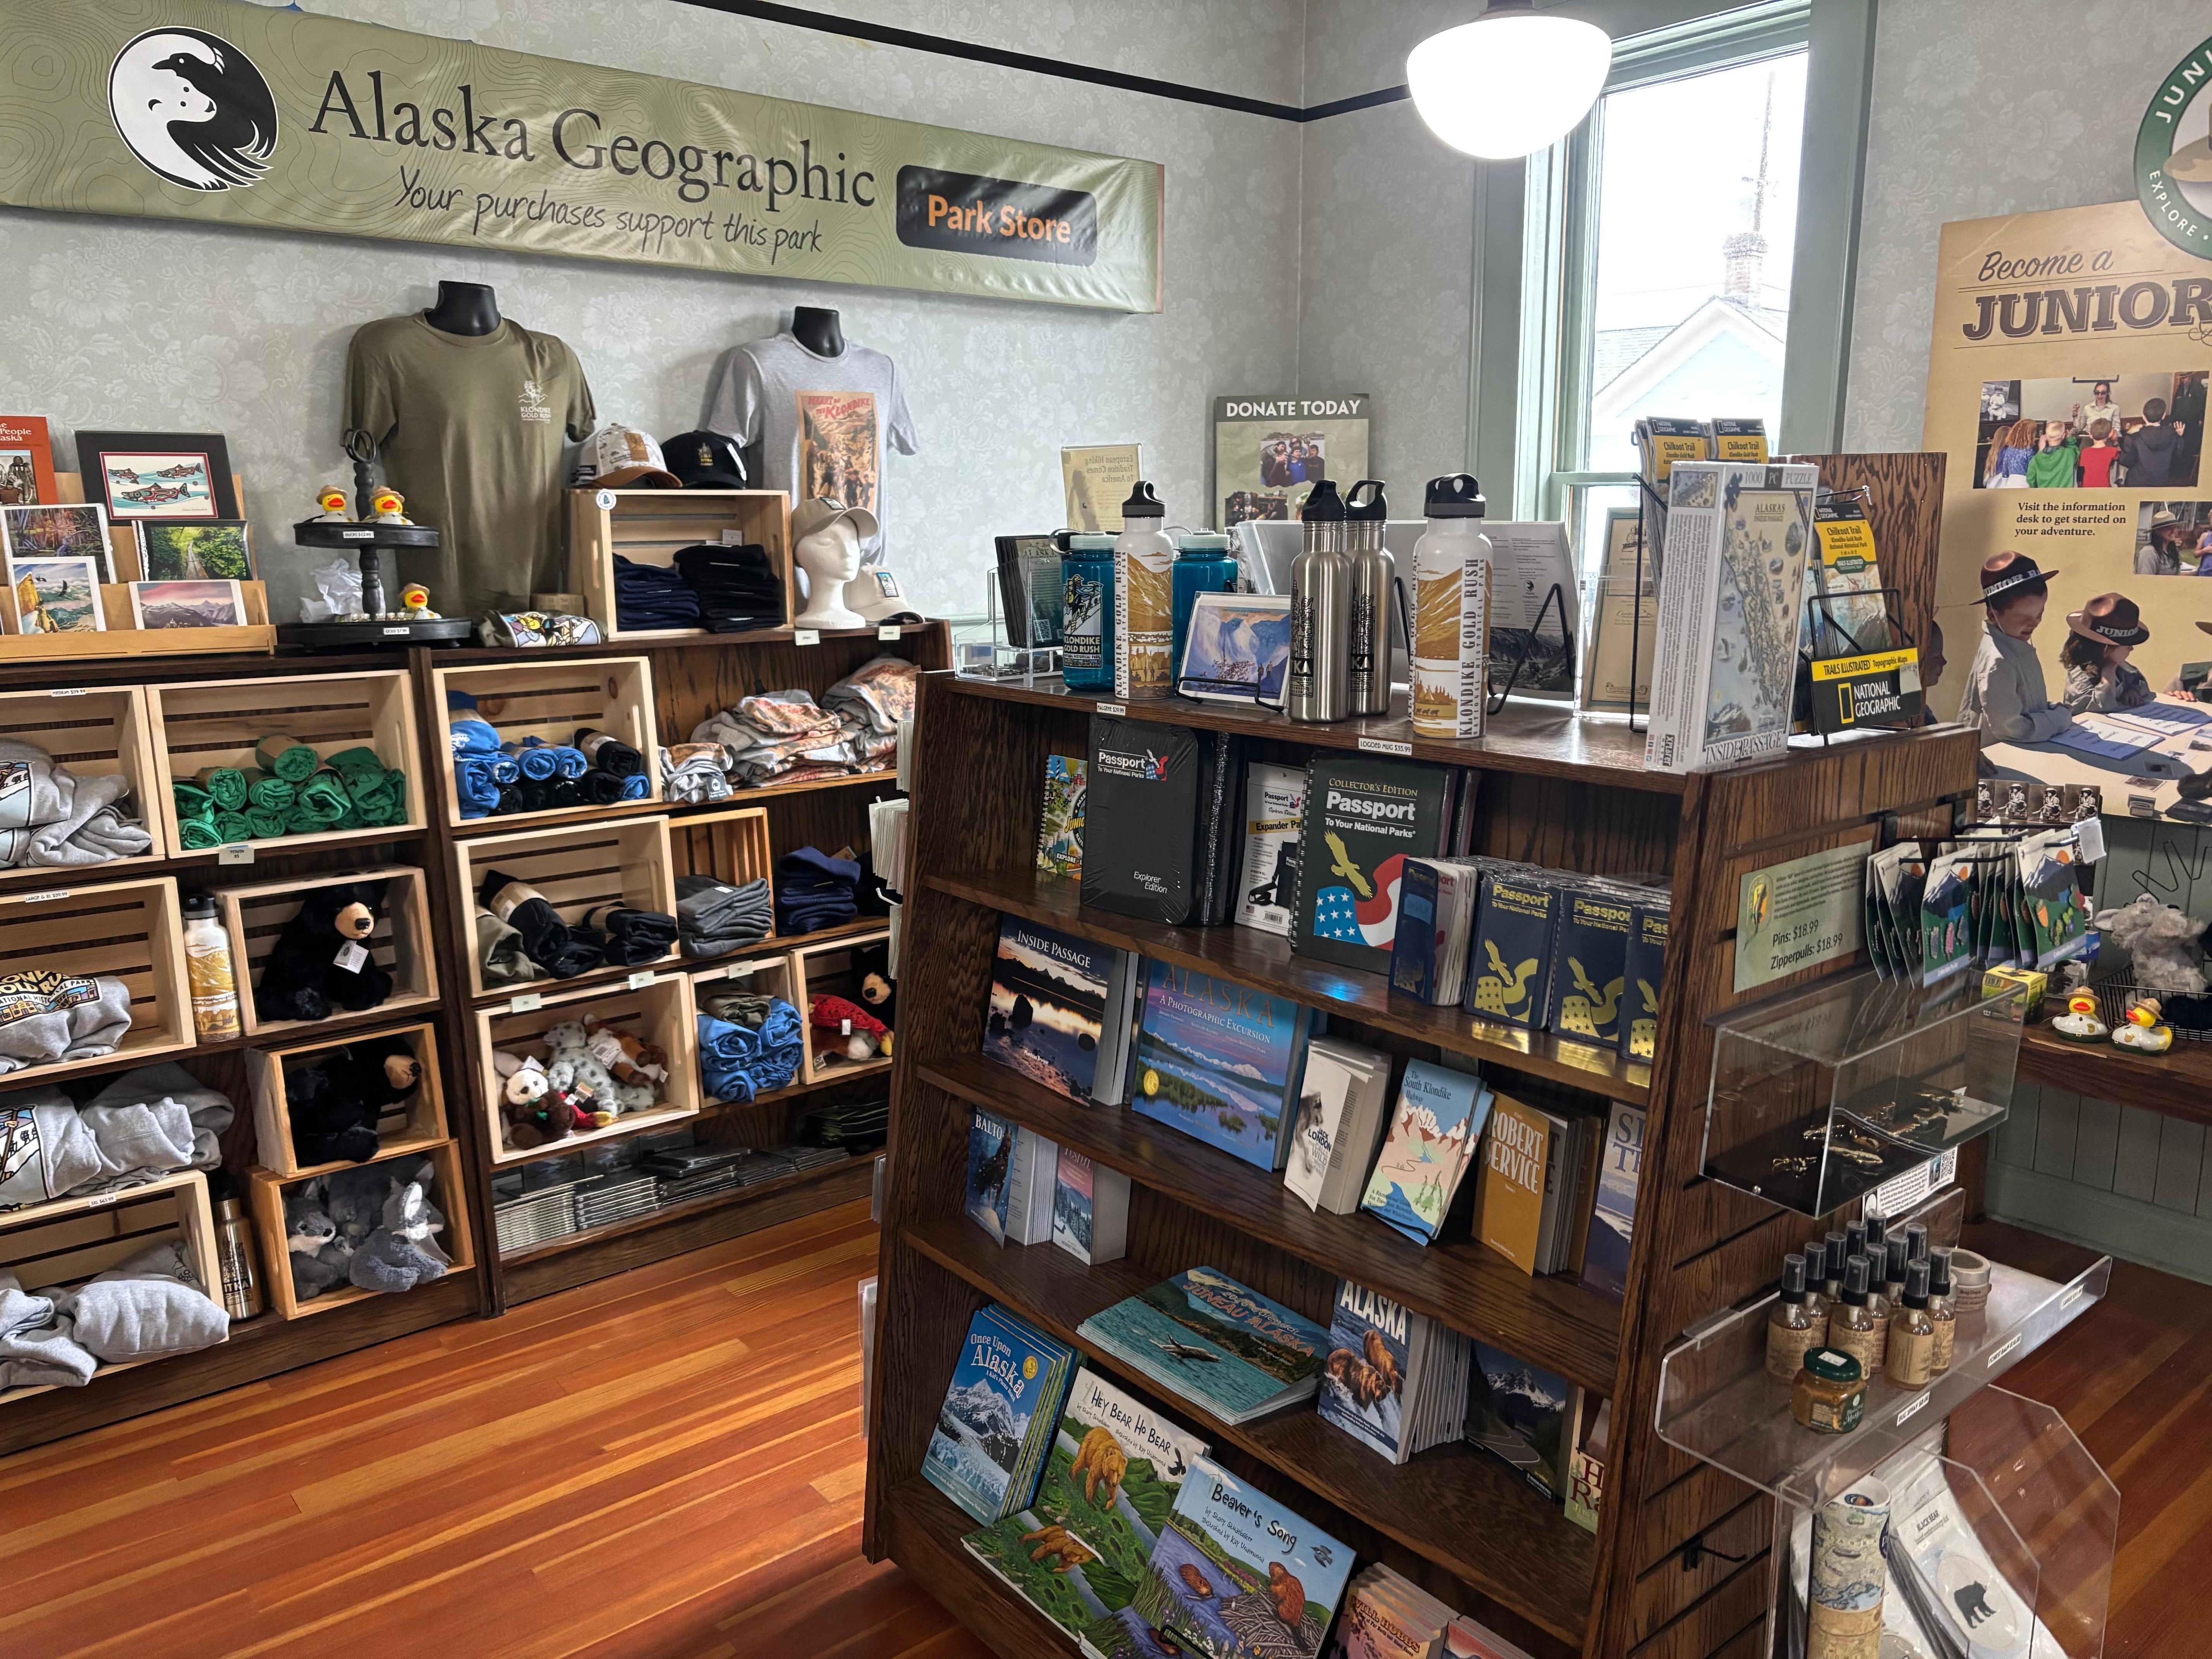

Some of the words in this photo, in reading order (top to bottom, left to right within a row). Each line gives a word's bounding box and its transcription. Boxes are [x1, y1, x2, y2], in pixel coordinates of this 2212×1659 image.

[309, 70, 534, 163] Alaska
[551, 108, 876, 213] Geographic
[400, 165, 464, 211] Your
[474, 189, 605, 235] purchases
[617, 210, 714, 254] support
[723, 210, 768, 247] this
[771, 219, 823, 266] park
[2149, 170, 2197, 237] EXPLORE
[928, 194, 992, 234] Park
[999, 204, 1071, 244] Store
[1978, 249, 2083, 282] Become
[2092, 249, 2114, 271] a
[1962, 277, 2212, 341] JUNIOR
[825, 398, 870, 420] KLONDIKE
[1226, 400, 1296, 417] DONATE
[1301, 399, 1360, 416] TODAY
[0, 428, 32, 436] People
[1664, 442, 1683, 450] Chilkoot
[1685, 442, 1695, 451] Trail
[1728, 441, 1748, 450] Chilkoot
[1749, 441, 1759, 450] Trail
[1745, 471, 1762, 484] 1000
[1769, 472, 1779, 484] PC
[1785, 472, 1812, 484] PUZZLE
[2018, 502, 2040, 511] Visit
[2043, 502, 2059, 511] the
[2062, 502, 2125, 511] information
[1827, 526, 1850, 536] Chilkoot
[1850, 526, 1862, 534] Trail
[2016, 515, 2039, 523] desk
[2054, 516, 2069, 525] get
[2073, 515, 2109, 524] started
[2014, 528, 2039, 538] your
[2041, 527, 2095, 536] adventure.
[1464, 559, 1479, 598] RUSH
[1462, 611, 1476, 649] GOLD
[1475, 598, 1483, 668] HISTORICAL
[1823, 664, 1840, 675] TRAILS
[1841, 659, 1870, 673] ILLUSTRATED
[1872, 657, 1897, 668] Topographic
[1898, 655, 1908, 664] Maps
[1460, 661, 1475, 736] KLONDIKE
[1853, 680, 1891, 700] NATIONAL
[1855, 696, 1901, 718] GEOGRAPHIC
[1360, 740, 1381, 749] LOGOED
[1382, 742, 1393, 751] MUG
[1394, 744, 1411, 753] $35.99
[1705, 741, 1742, 764] INSIDE
[1742, 731, 1783, 756] PASSAGE
[1099, 752, 1146, 769] Passport
[1113, 769, 1130, 777] National
[1264, 792, 1288, 802] Passport
[1329, 778, 1381, 792] COLLECTOR'S
[1382, 784, 1418, 797] EDITION
[1326, 791, 1415, 821] Passport
[1256, 821, 1288, 832] Expander
[1325, 818, 1334, 826] To
[1335, 819, 1353, 831] Your
[1354, 822, 1388, 835] National
[1389, 826, 1413, 838] Parks
[1056, 853, 1076, 864] EXPLORE
[1133, 871, 1161, 884] Explorer
[1145, 882, 1167, 894] Edition
[1493, 883, 1549, 908] Passport
[1574, 900, 1630, 921] Passpo
[1773, 933, 1791, 947] Pins:
[1793, 919, 1819, 941] $18.99
[1017, 930, 1050, 953] INSIDE
[1051, 942, 1091, 968] PASSAGE
[1771, 944, 1815, 970] Zipperpulls:
[1817, 933, 1843, 955] $18.99
[0, 982, 39, 994] OLD
[0, 995, 32, 1005] ATIONAL
[1162, 965, 1274, 1028] ALASKA
[1159, 995, 1165, 1005] A
[1168, 996, 1224, 1026] PHOTOGRAPHIC
[1227, 1018, 1271, 1044] EXCURSION
[1411, 1070, 1419, 1079] The
[1404, 1076, 1422, 1092] South
[1423, 1081, 1451, 1100] Klondike
[1406, 1090, 1424, 1103] Highway
[975, 1114, 1002, 1140] BALTO
[1317, 1128, 1329, 1140] JACK
[1487, 1109, 1543, 1162] ROBERT
[1308, 1128, 1332, 1152] LONDON
[1485, 1138, 1540, 1195] SERVICE
[1183, 1282, 1249, 1317] JUNEAU
[1340, 1279, 1406, 1346] ALASKA
[970, 1333, 991, 1344] Once
[993, 1336, 1012, 1357] Upon
[1244, 1318, 1315, 1357] ALASKA
[970, 1345, 1025, 1399] Alaska
[989, 1371, 998, 1381] Kid's
[998, 1377, 1008, 1391] Photo
[1008, 1389, 1016, 1403] Book
[1077, 1403, 1081, 1412] by
[1133, 1441, 1138, 1449] by
[1091, 1386, 1109, 1417] HEY
[1110, 1403, 1132, 1430] BEAR
[1147, 1428, 1171, 1456] BEAR
[1205, 1506, 1211, 1517] by
[1212, 1512, 1226, 1527] Stacy
[1227, 1521, 1253, 1542] Studebaker
[1211, 1483, 1262, 1528] Beaver's
[1267, 1520, 1297, 1555] Song
[1224, 1531, 1231, 1541] by
[1230, 1535, 1240, 1548] Kay
[1240, 1542, 1265, 1564] Underwood
[1352, 1594, 1379, 1623] WILL
[1380, 1616, 1420, 1654] HOBBS
